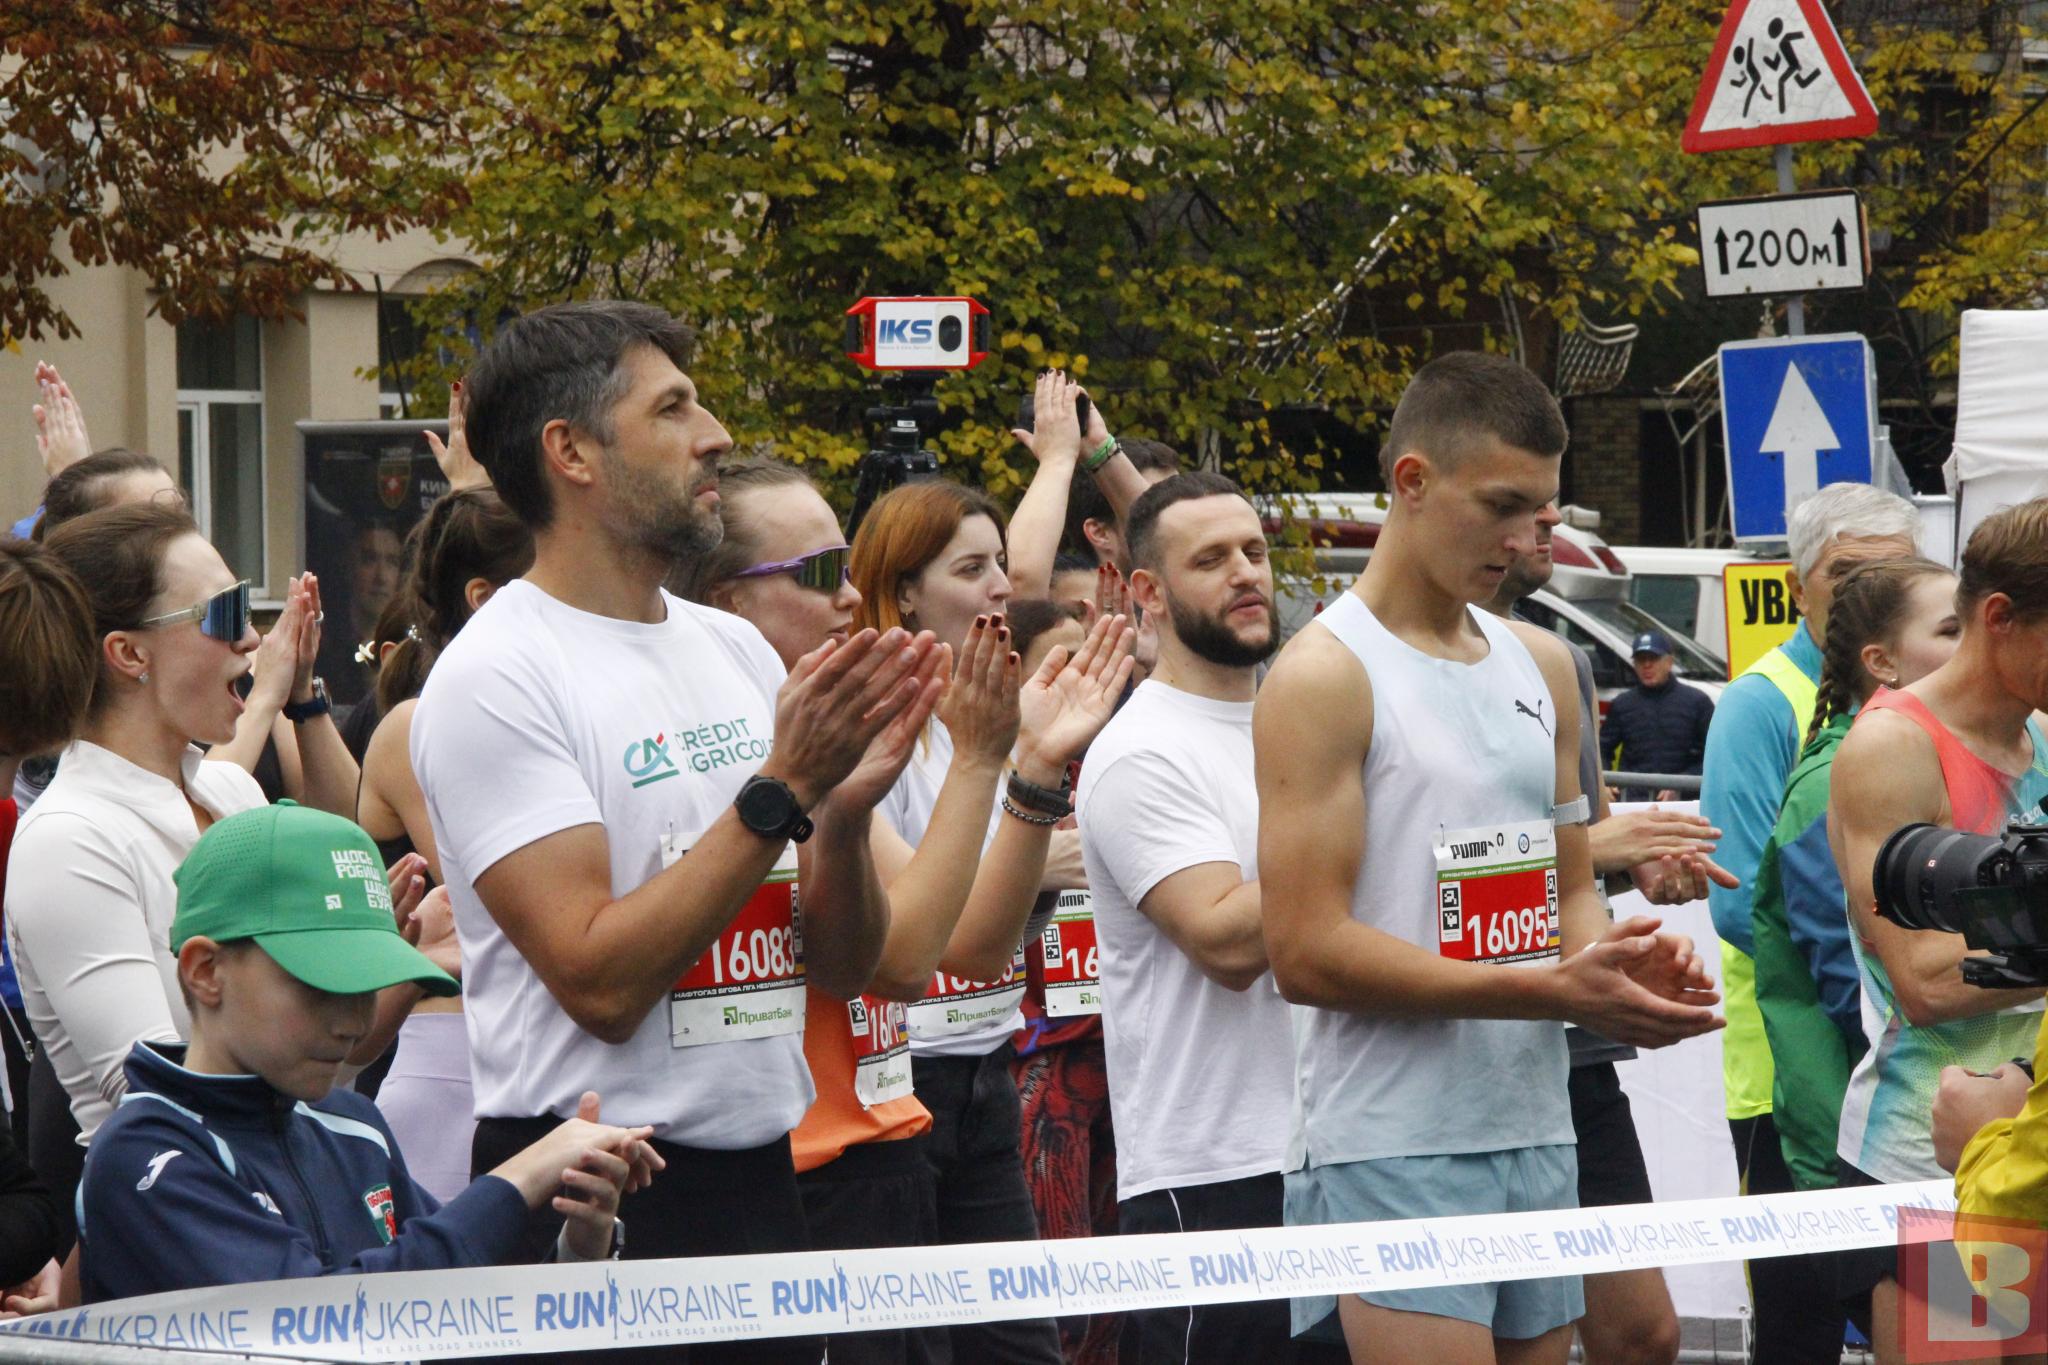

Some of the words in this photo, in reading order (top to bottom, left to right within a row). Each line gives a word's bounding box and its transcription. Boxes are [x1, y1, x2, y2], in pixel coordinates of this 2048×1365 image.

[878, 319, 933, 344] IKS
[1740, 578, 1804, 625] УВА
[331, 849, 374, 866] ЩОСЬ
[1449, 840, 1488, 860] PUMA
[336, 864, 381, 881] РОБИШ
[1058, 894, 1085, 907] UMA
[1467, 905, 1548, 957] 16095
[711, 926, 795, 984] 16083
[674, 989, 718, 999] НАФТОГАЗ
[718, 986, 742, 995] БІГОВА
[272, 1304, 351, 1345] RUN
[535, 1291, 605, 1331] RUN
[772, 1278, 837, 1316] RUN
[988, 1265, 1050, 1301] RUN
[1189, 1252, 1249, 1287] RUN
[1376, 1240, 1435, 1273] RUN
[1553, 1227, 1610, 1259] RUN
[1720, 1215, 1776, 1244] RUN
[904, 1312, 931, 1320] ROAD
[937, 1308, 982, 1318] RUNNERS
[629, 1331, 643, 1339] WE
[678, 1328, 705, 1336] ROAD
[713, 1324, 762, 1334] RUNNERS
